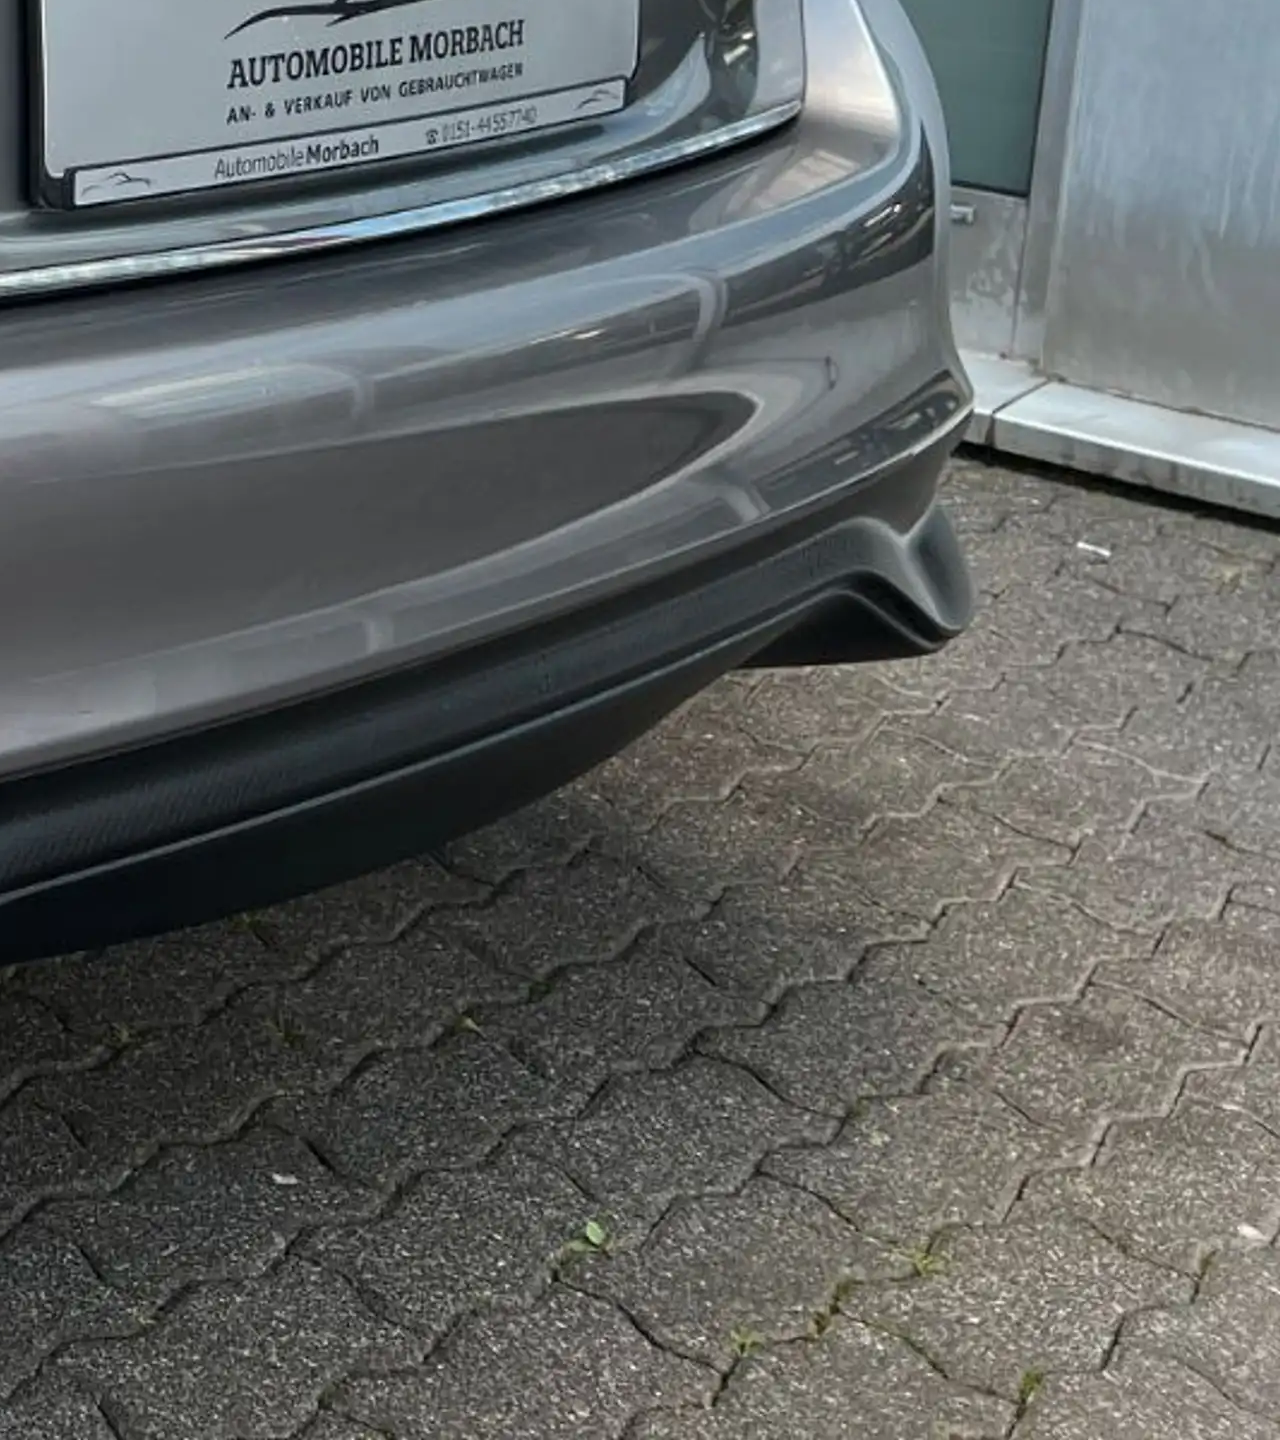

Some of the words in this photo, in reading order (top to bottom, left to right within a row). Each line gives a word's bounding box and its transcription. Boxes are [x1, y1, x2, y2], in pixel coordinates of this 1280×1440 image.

[226, 37, 404, 89] AUTOMOBILE
[408, 19, 525, 63] MORBACH
[226, 107, 257, 125] AN-
[264, 103, 276, 118] &
[283, 90, 353, 116] VERKAUF
[360, 84, 391, 103] VON
[398, 62, 524, 98] GEBRAUCHTWAGEN
